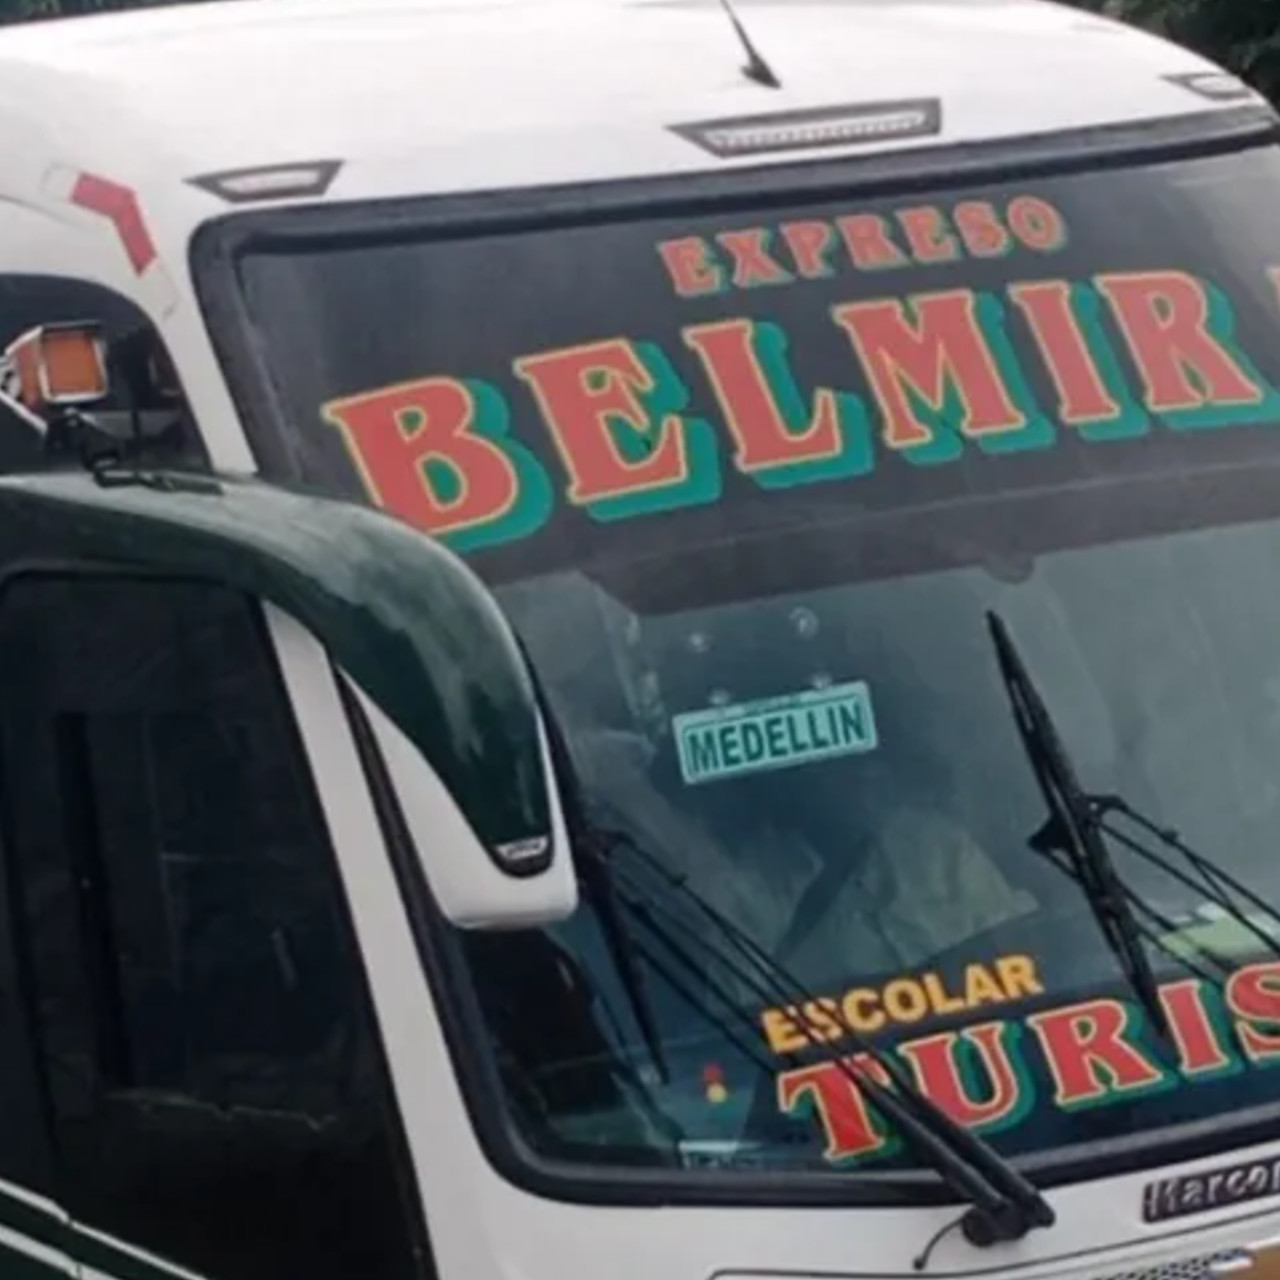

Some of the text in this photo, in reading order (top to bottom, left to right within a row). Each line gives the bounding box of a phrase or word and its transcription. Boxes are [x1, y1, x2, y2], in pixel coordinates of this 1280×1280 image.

[656, 193, 1068, 297] EXPRESO
[686, 699, 867, 775] MEDELLIN
[760, 953, 1044, 1054] ESCOLAR
